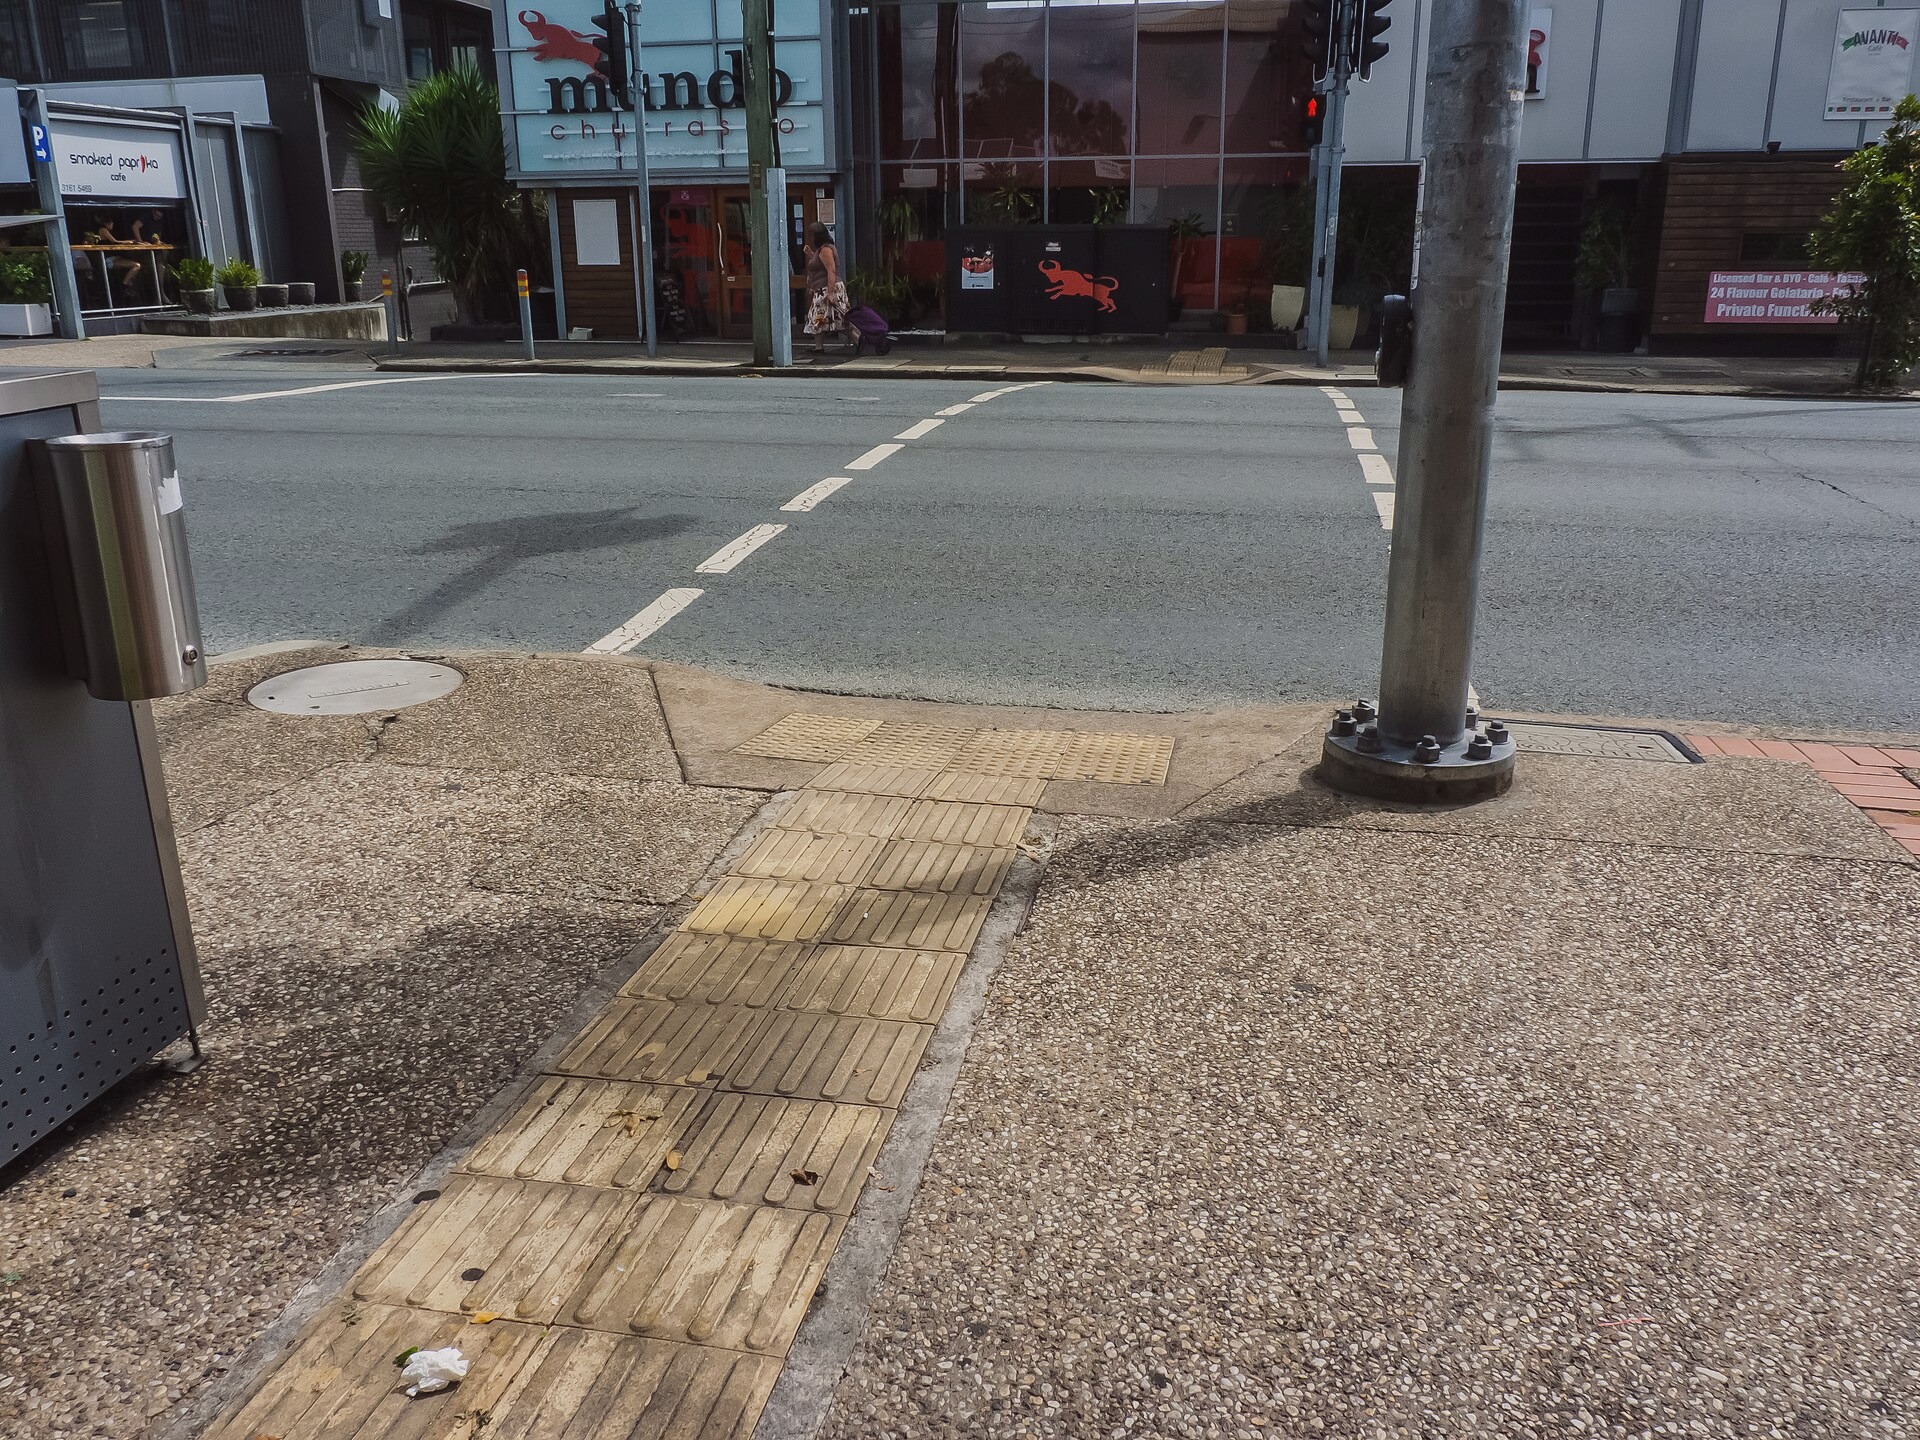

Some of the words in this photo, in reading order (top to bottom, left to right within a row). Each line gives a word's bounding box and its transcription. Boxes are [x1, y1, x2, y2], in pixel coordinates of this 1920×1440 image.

[1854, 29, 1899, 47] AVANTI
[33, 126, 43, 146] P
[550, 118, 795, 140] churaso
[69, 152, 112, 166] smoked
[110, 173, 126, 181] cafe
[62, 183, 76, 192] 3161
[1713, 273, 1755, 283] Licensed
[1756, 273, 1773, 283] Bar
[1783, 273, 1801, 283] BYO
[1710, 287, 1725, 298] 24
[1726, 287, 1769, 298] Flavour
[1716, 303, 1765, 317] Private
